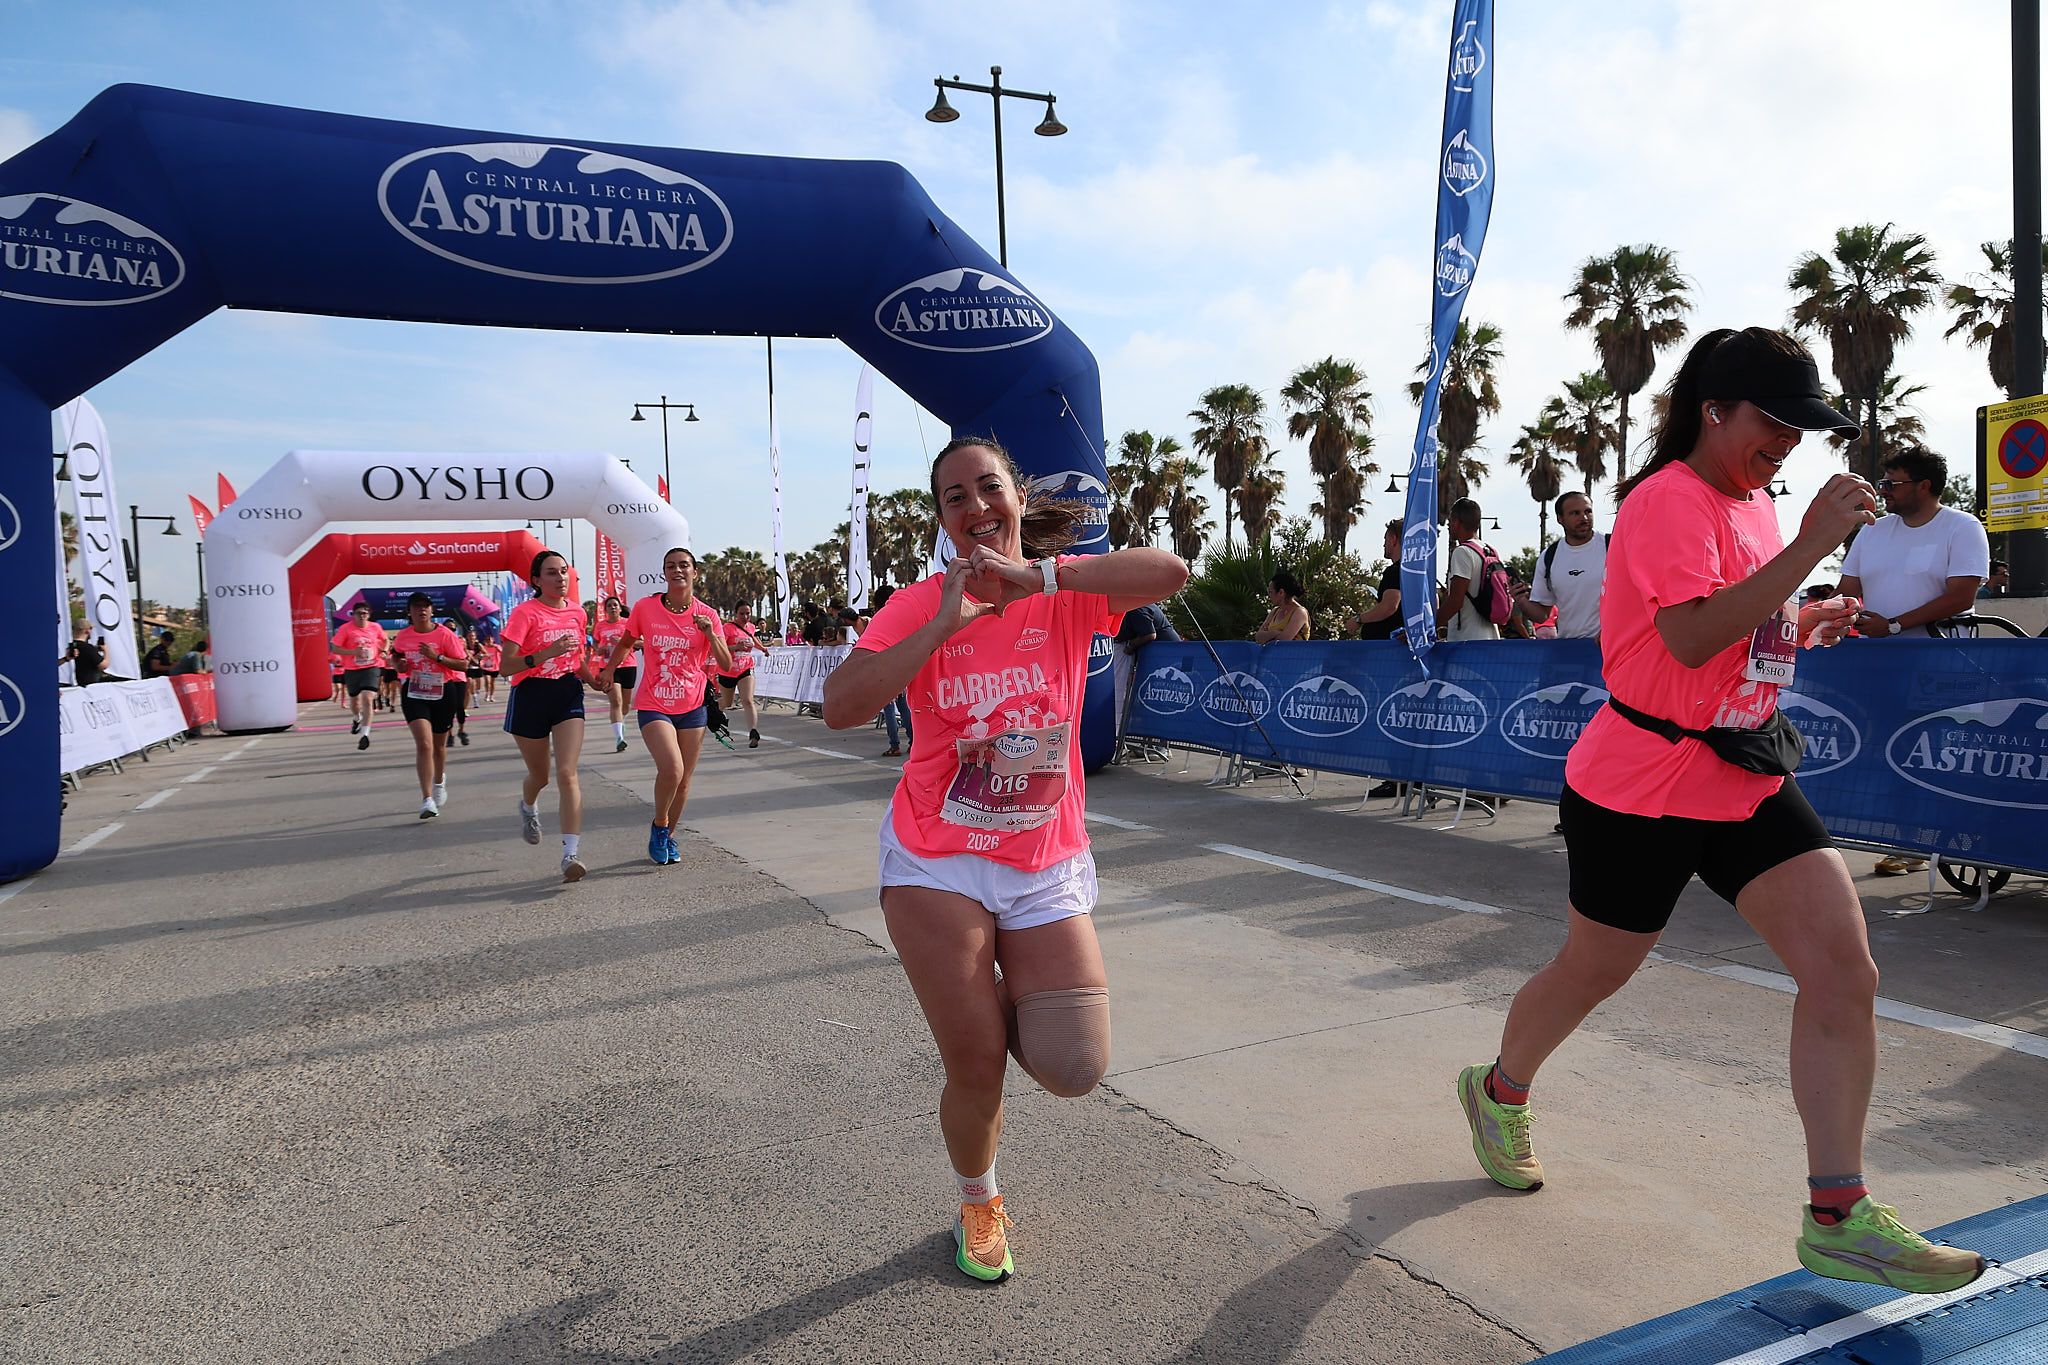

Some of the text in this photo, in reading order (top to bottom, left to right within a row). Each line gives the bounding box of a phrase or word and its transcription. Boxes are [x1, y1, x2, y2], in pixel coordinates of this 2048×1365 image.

[465, 171, 697, 206] CENTRAL LECHERA
[409, 169, 710, 252] ASTURIANA
[0, 225, 158, 256] TRAL LECHERA
[0, 240, 164, 288] URIANA
[920, 295, 1034, 307] CENTRAL LECHERA
[891, 301, 1047, 332] ASTURIANA
[361, 464, 554, 501] OYSHO
[238, 507, 302, 521] OYSHO
[607, 503, 659, 514] OYSHO
[359, 540, 500, 559] Sports Santander
[639, 573, 666, 584] OYS
[215, 583, 274, 598] OYSHO
[652, 635, 690, 650] CARRERA
[669, 652, 682, 667] DE
[764, 654, 796, 675] OYSHO
[1757, 651, 1777, 661] CARRERA
[1777, 654, 1785, 662] DE
[220, 660, 279, 675] OYSHO
[654, 686, 686, 699] MUJER
[938, 662, 1047, 710] CARRERA
[1203, 689, 1263, 715] ASTURIANA
[1283, 695, 1359, 724] ASTURIANA
[1382, 702, 1477, 733] ASTURIANA
[1508, 708, 1588, 740] ASTUR
[1946, 731, 2031, 747] CENTRAL
[990, 773, 1029, 794] 016
[958, 795, 983, 810] CARRERA
[984, 804, 992, 812] DE
[955, 808, 993, 824] OYSHO
[1016, 817, 1037, 826] Santa
[966, 832, 1000, 850] 2026
